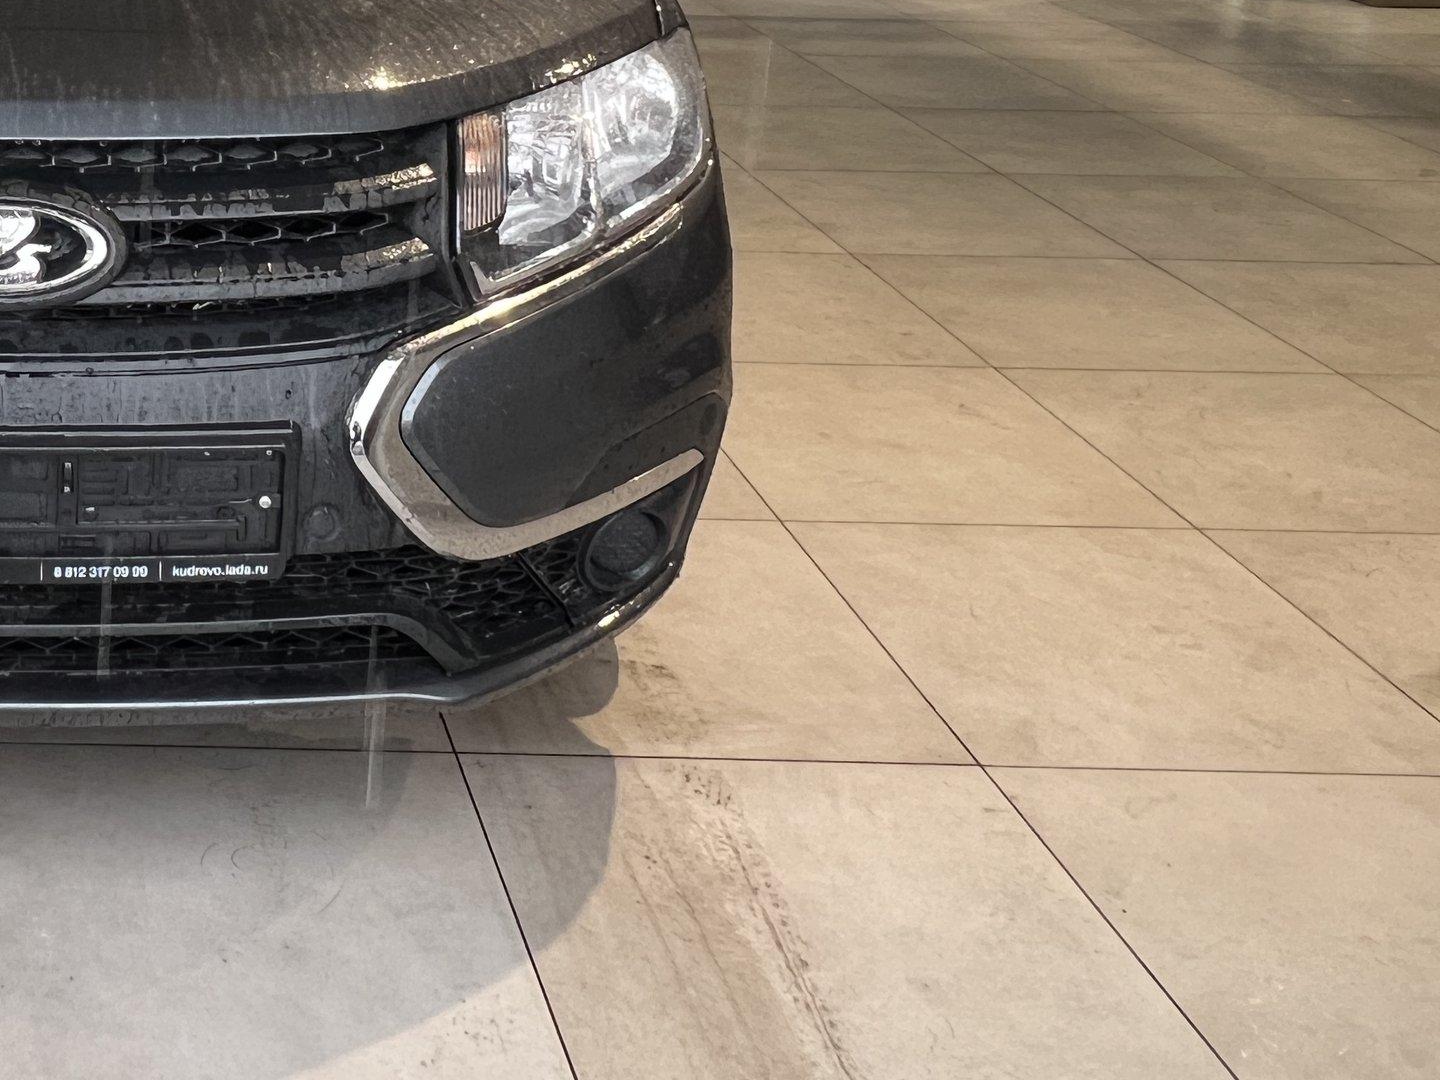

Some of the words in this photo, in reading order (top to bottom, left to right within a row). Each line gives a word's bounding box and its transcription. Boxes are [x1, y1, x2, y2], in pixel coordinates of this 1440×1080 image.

[64, 566, 87, 578] 812
[88, 566, 112, 578] 317
[172, 564, 269, 578] kudrovo.lada.ru
